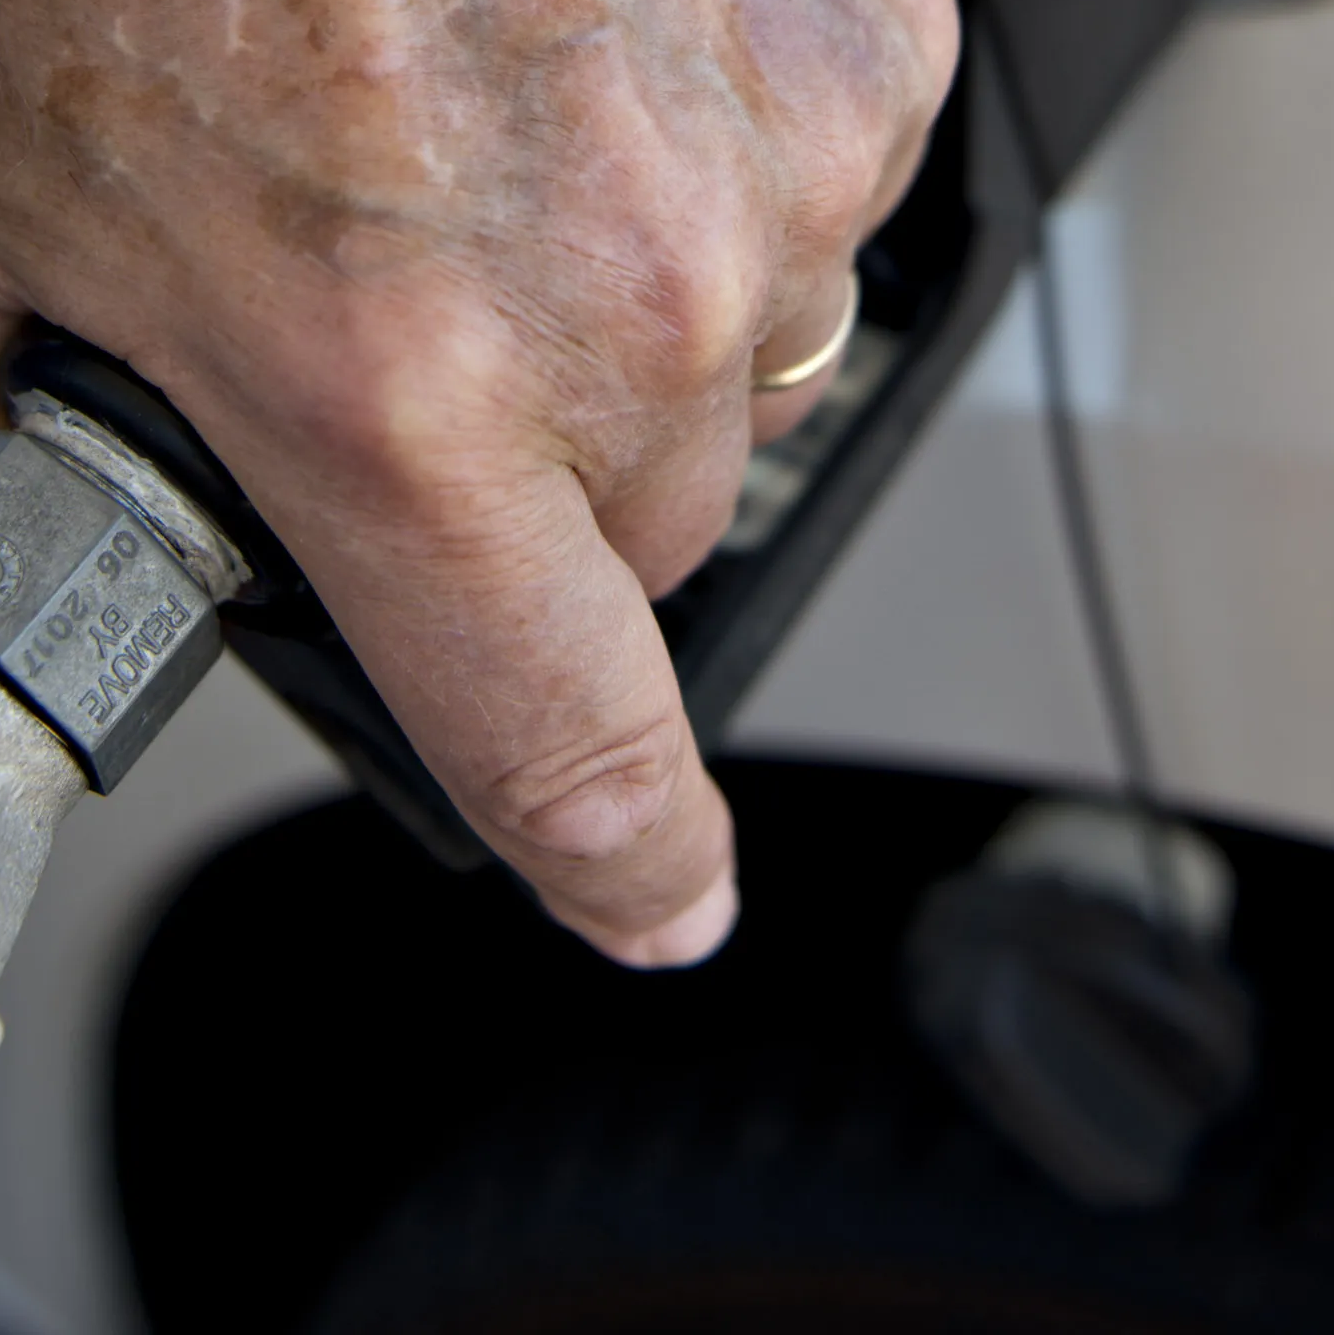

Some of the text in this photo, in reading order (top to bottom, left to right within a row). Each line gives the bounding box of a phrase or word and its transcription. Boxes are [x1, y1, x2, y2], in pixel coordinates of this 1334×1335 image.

[23, 529, 141, 678] 06 2017
[78, 593, 191, 724] REMOVE
[89, 603, 131, 660] BY
